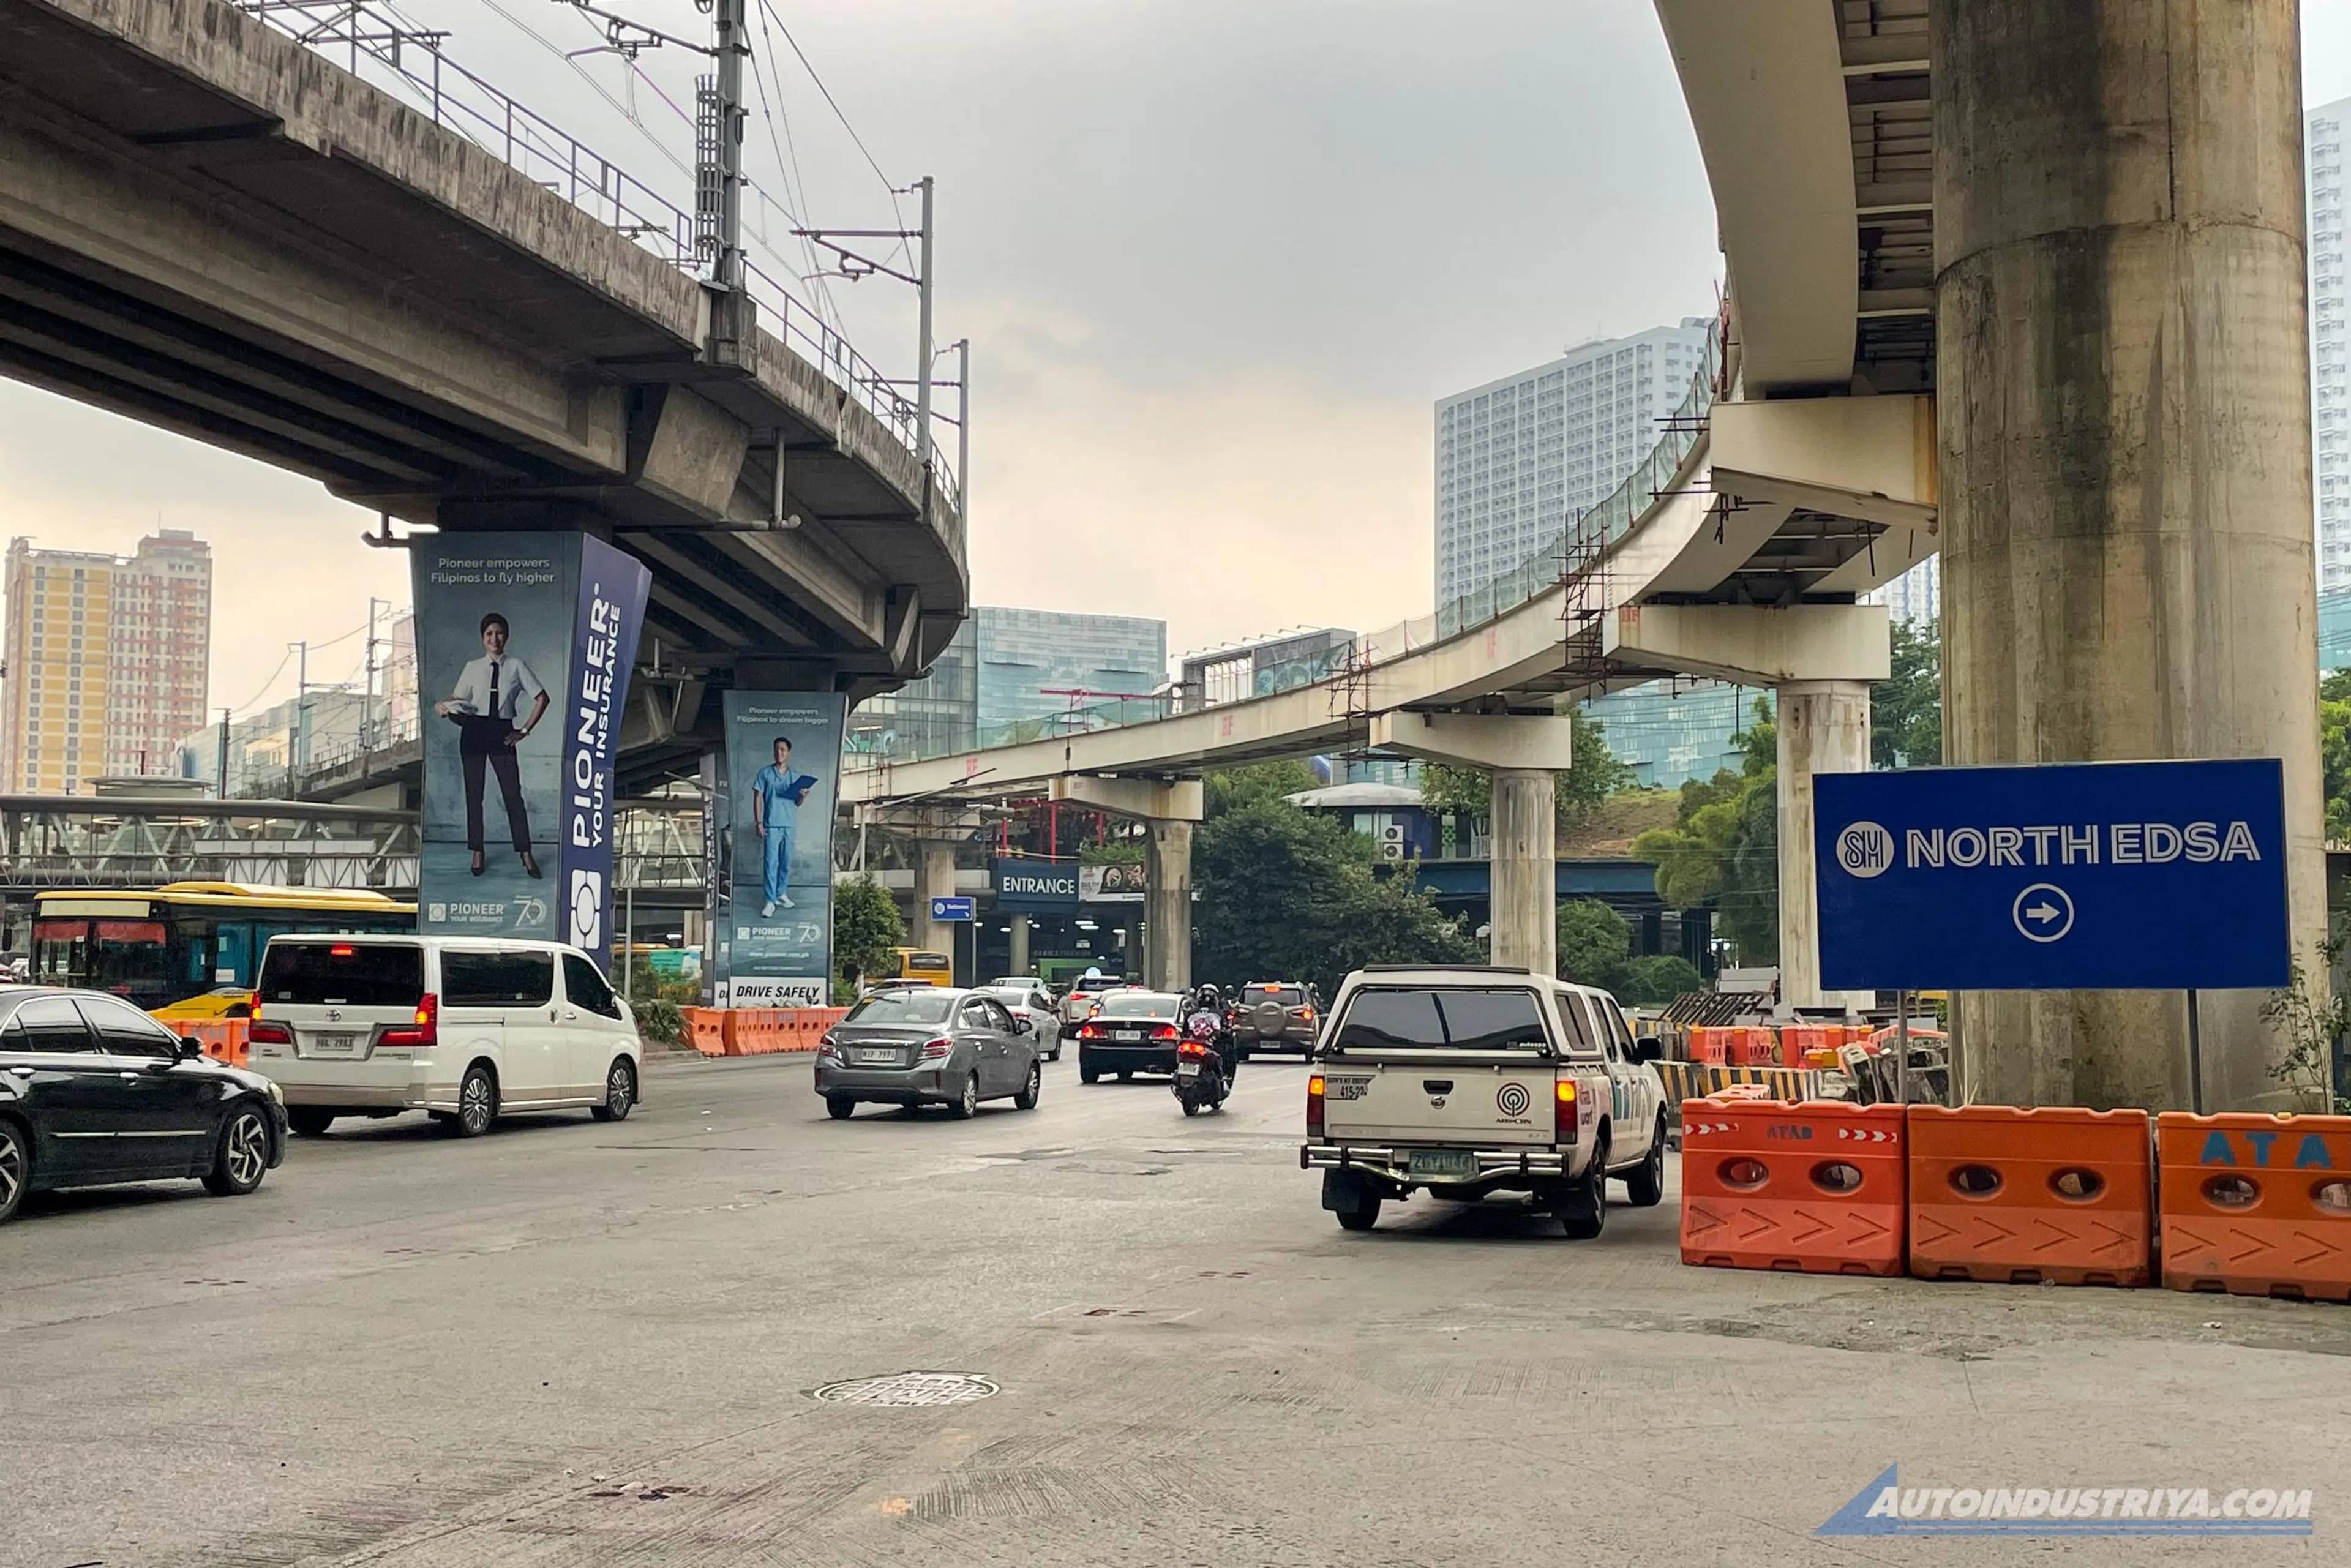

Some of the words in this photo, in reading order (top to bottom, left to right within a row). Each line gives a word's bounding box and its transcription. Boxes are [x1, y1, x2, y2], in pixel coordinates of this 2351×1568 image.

[438, 558, 484, 568] Pioneer
[486, 558, 550, 570] empowers
[431, 572, 481, 585] Filipinos
[484, 573, 496, 583] to
[499, 572, 514, 585] fly
[516, 572, 555, 585] higher
[596, 604, 621, 759] INSURANCE
[592, 772, 604, 849] YOUR
[1842, 828, 1887, 871] SM
[1906, 824, 2100, 868] NORTH
[2110, 821, 2261, 865] EDSA
[1002, 876, 1076, 895] ENTRANCE
[450, 903, 504, 915] PIONEER
[752, 926, 791, 936] PIONEER
[737, 986, 773, 997] DRIVE
[776, 986, 819, 998] SAFELY
